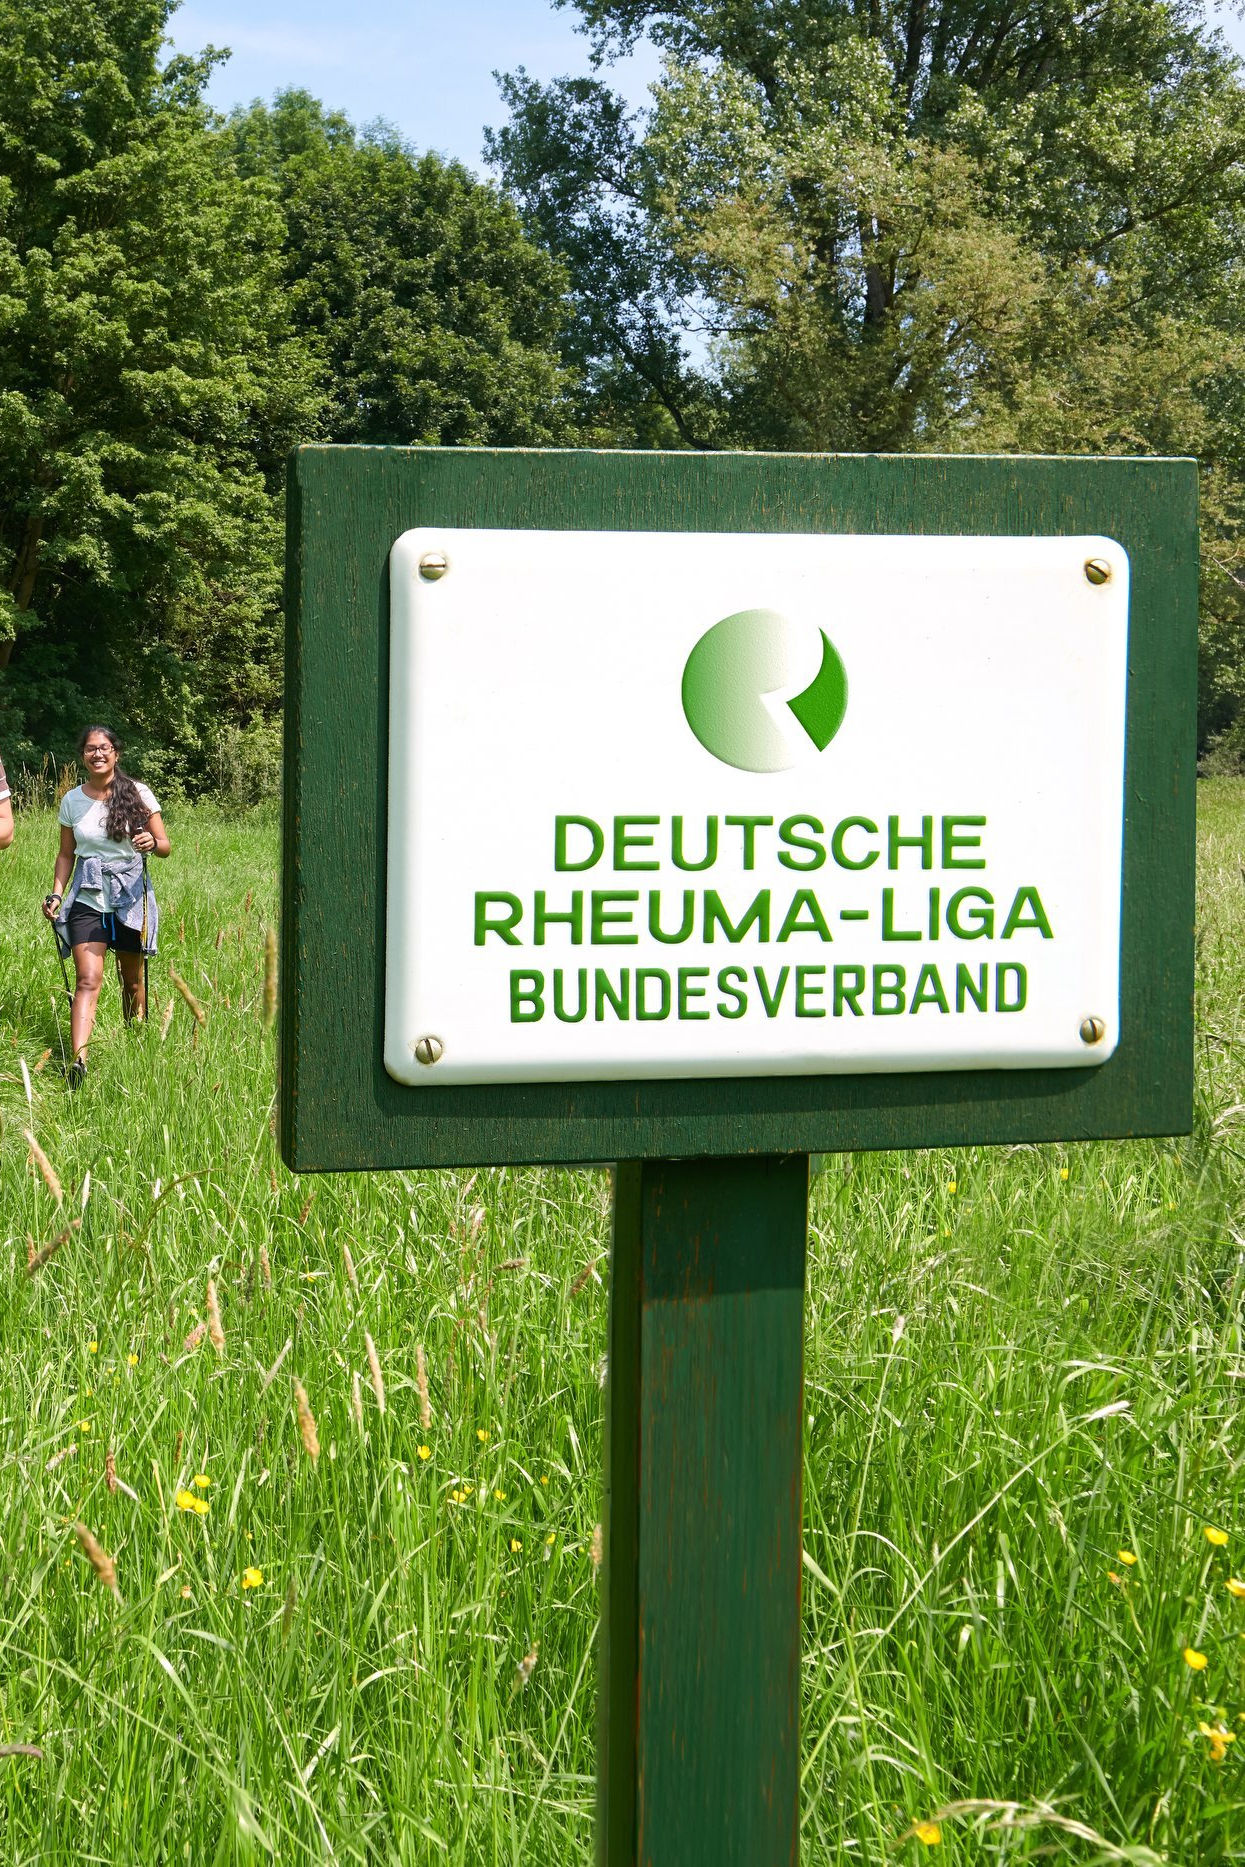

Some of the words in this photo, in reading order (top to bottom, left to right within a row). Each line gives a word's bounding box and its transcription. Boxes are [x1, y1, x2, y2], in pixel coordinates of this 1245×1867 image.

[553, 814, 988, 873] DEUTSCHE
[472, 885, 1055, 947] RHEUMA-LIGA
[509, 961, 1029, 1025] BUNDESVERBAND
